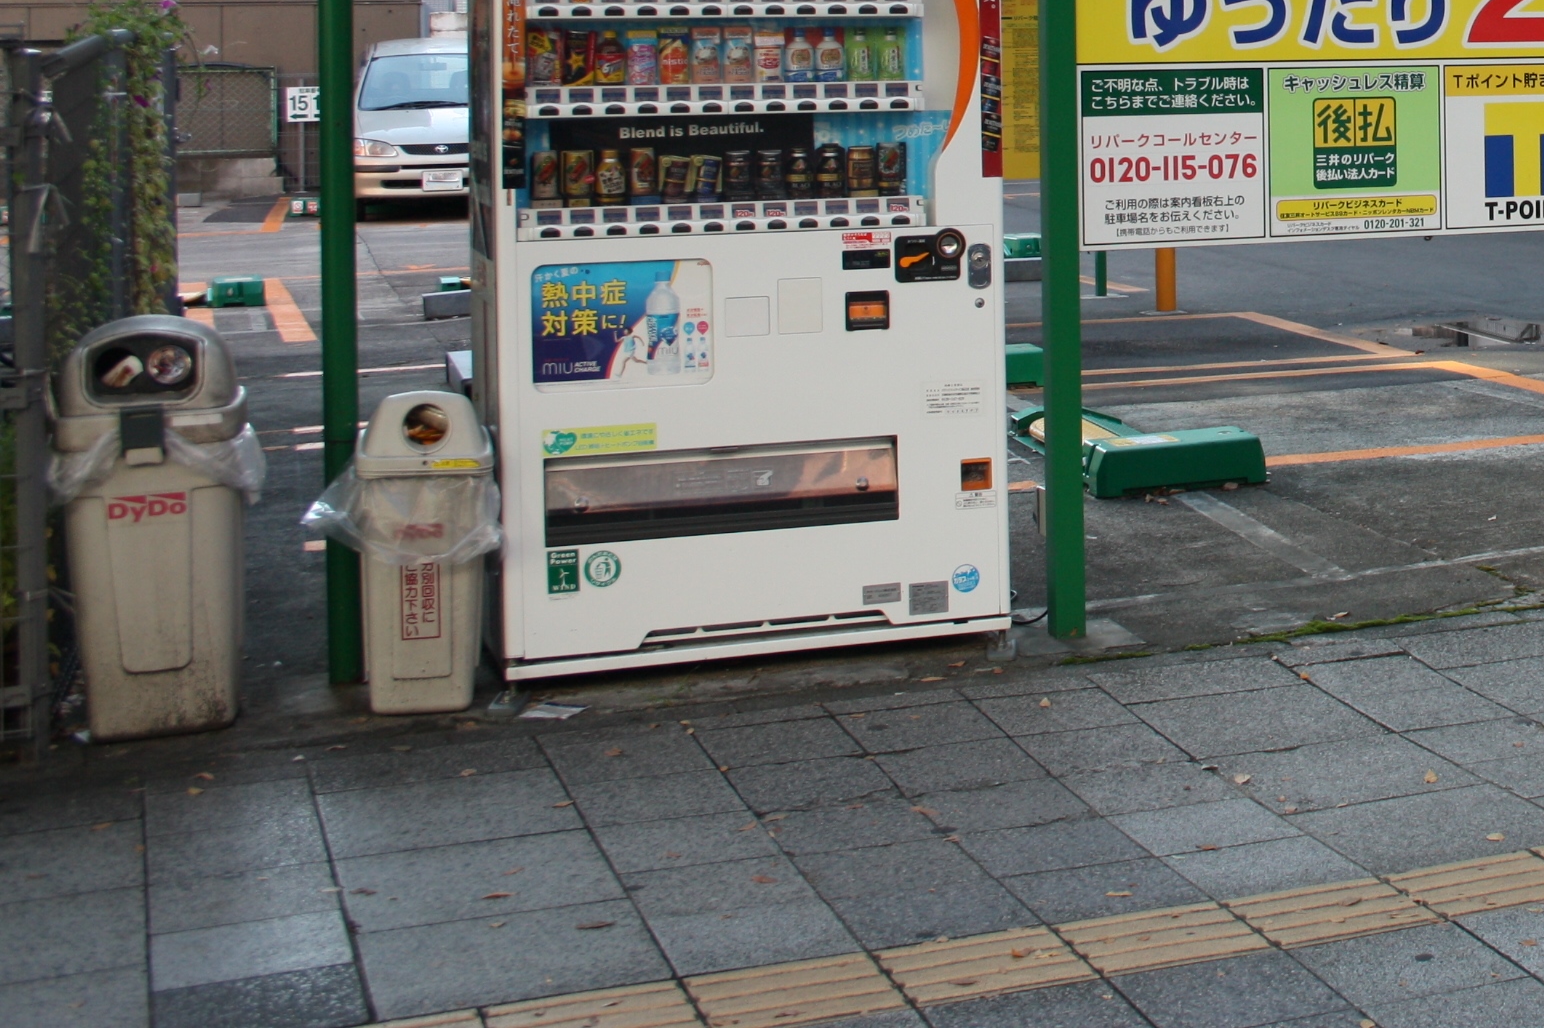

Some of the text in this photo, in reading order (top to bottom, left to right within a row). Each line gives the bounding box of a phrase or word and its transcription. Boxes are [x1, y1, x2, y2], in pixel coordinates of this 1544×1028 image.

[1091, 76, 1250, 93] ご不明な点、トラブル時は
[1284, 73, 1425, 93] キャッシュレス精算
[290, 95, 308, 111] 15
[1091, 93, 1256, 110] こちらまでご連絡ください。
[619, 122, 764, 139] Blend is Beautiful.
[1316, 102, 1393, 144] 後払
[1091, 131, 1257, 149] リパークコールセンター
[1316, 152, 1395, 167] 三井のリパーク
[1090, 153, 1257, 184] 0120-115-076
[1316, 167, 1395, 182] 後払い法人カード
[1104, 194, 1245, 211] ご利用の際は案内看板右上の
[1313, 198, 1403, 211] リパークビジネスカード
[1104, 209, 1240, 226] 駐車場名をお伝えください。
[1364, 218, 1425, 230] 0120-201-321
[541, 279, 627, 308] 熱中症
[541, 309, 626, 336] 対策に!
[108, 498, 187, 523] DyDo
